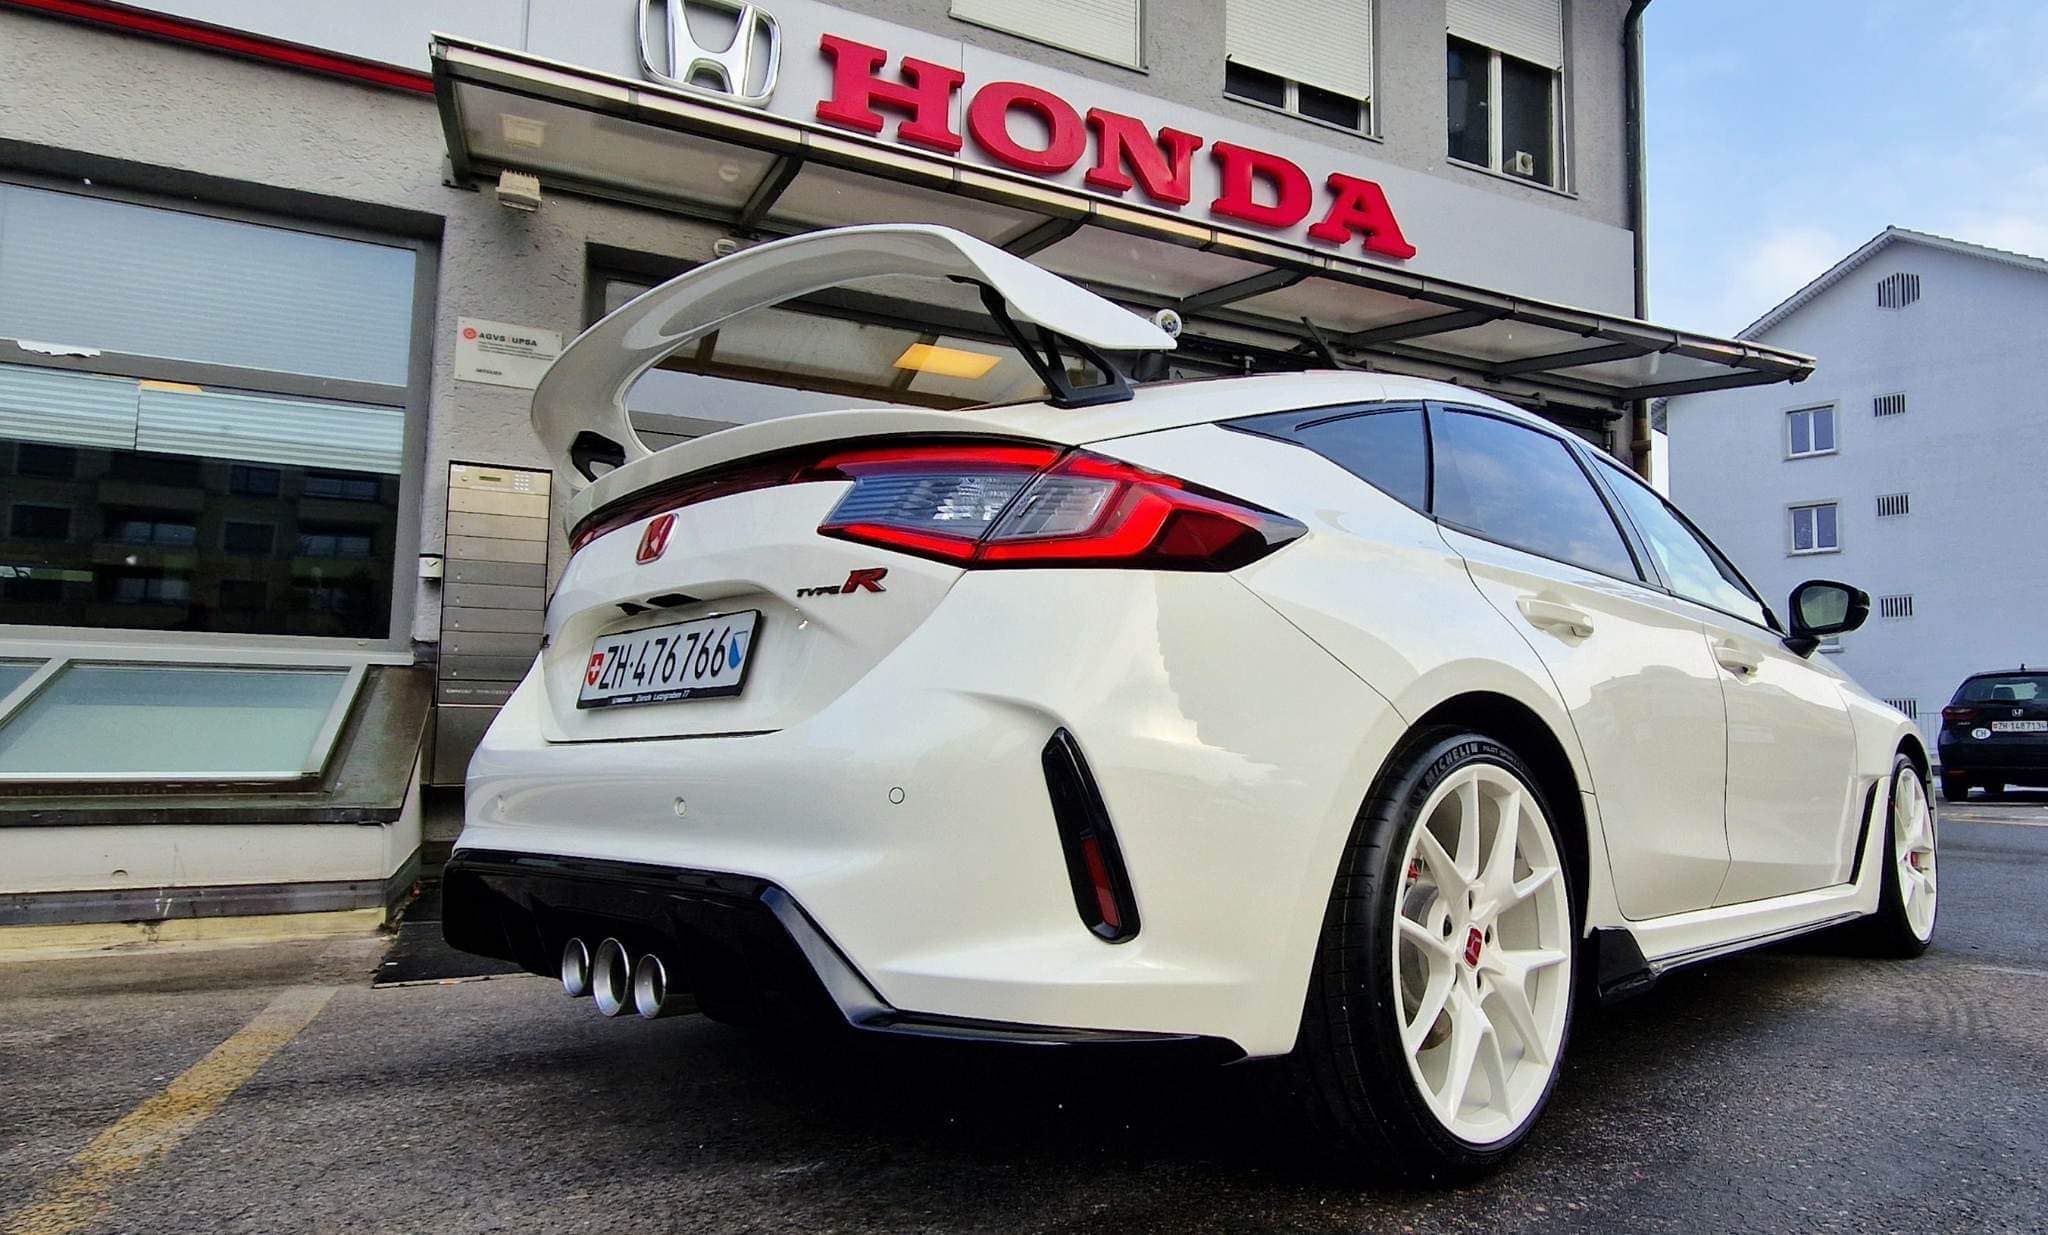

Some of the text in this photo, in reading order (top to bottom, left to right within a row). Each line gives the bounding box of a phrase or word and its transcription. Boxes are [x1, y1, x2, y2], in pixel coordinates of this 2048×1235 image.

[816, 33, 1416, 260] HONDA
[479, 332, 538, 347] AGVS UPSA
[796, 567, 889, 598] TYPE R
[1975, 729, 1987, 738] CH
[1424, 742, 1479, 786] MICHELIN
